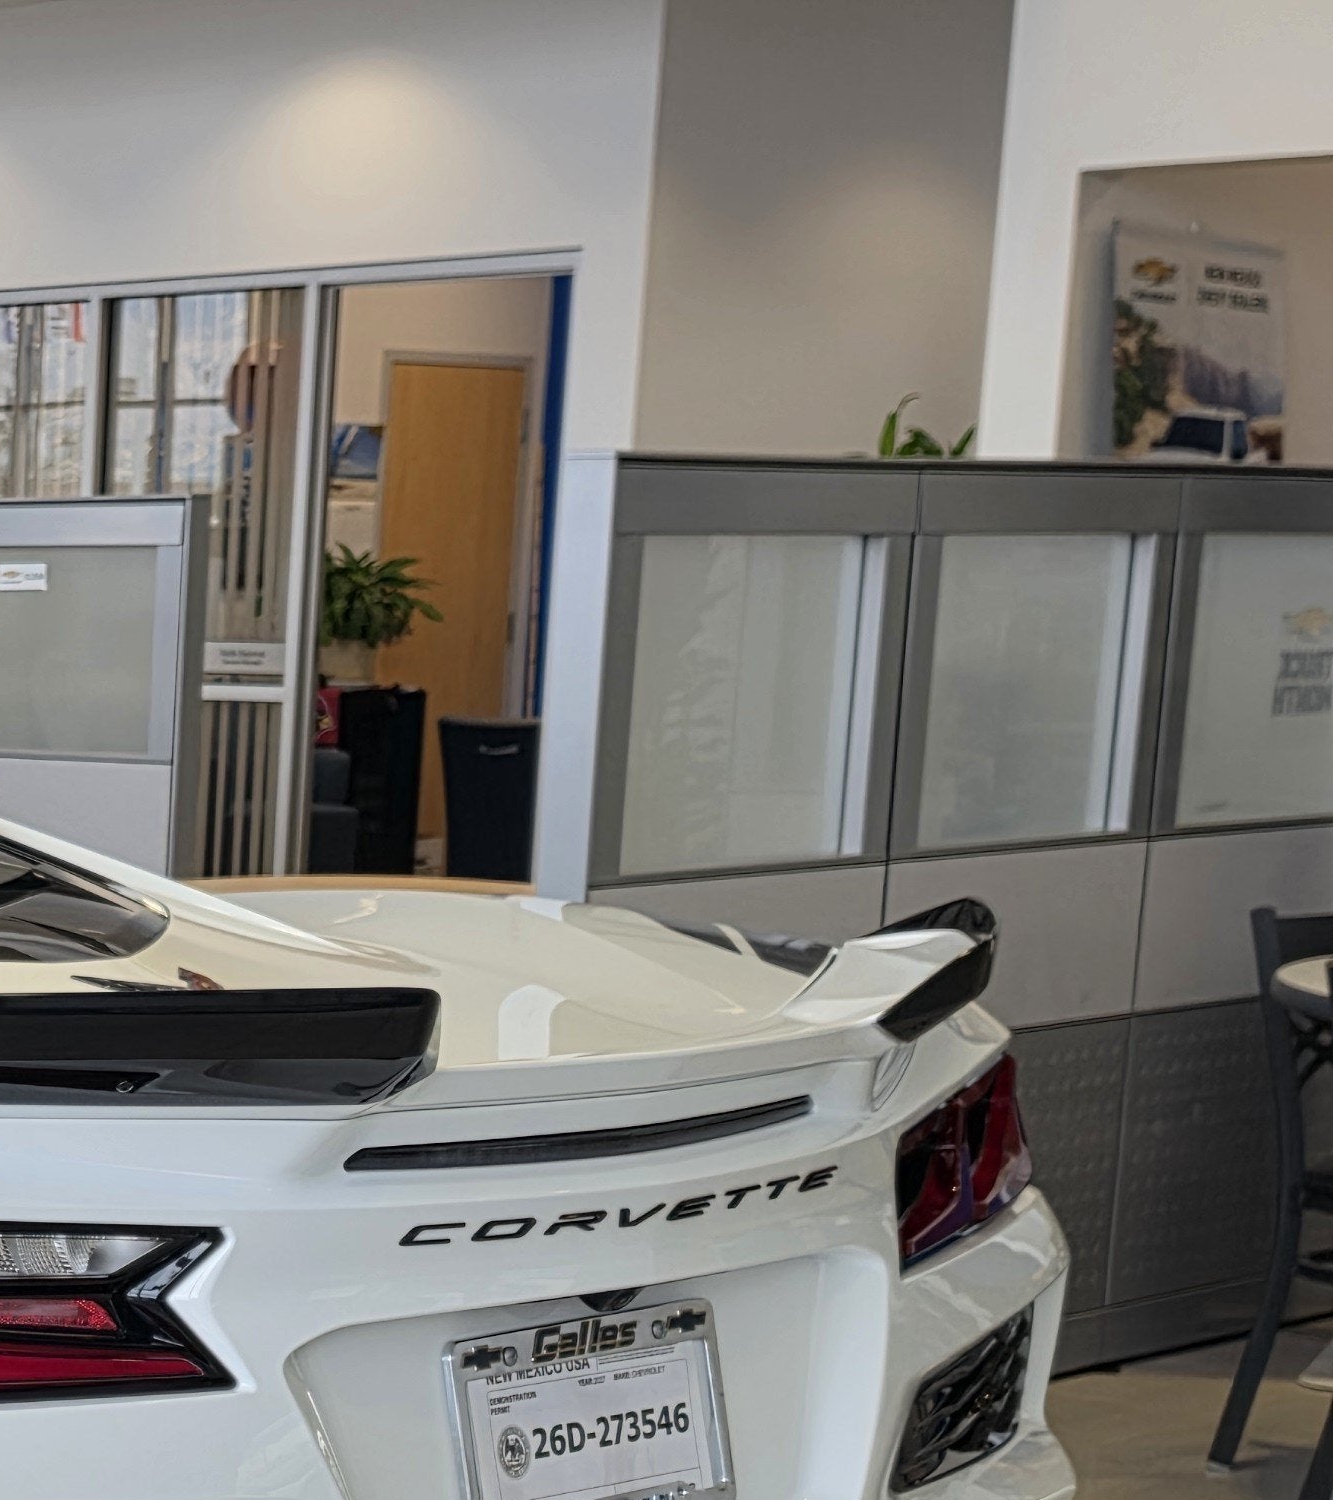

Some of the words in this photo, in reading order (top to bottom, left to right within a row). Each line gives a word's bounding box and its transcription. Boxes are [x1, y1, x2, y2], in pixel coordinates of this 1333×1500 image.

[398, 1165, 839, 1247] CORVETTE
[531, 1318, 638, 1364] Galles
[490, 1391, 537, 1406] DEMONSTRATION
[490, 1406, 511, 1416] PERMIT
[532, 1402, 690, 1460] 26D-273546
